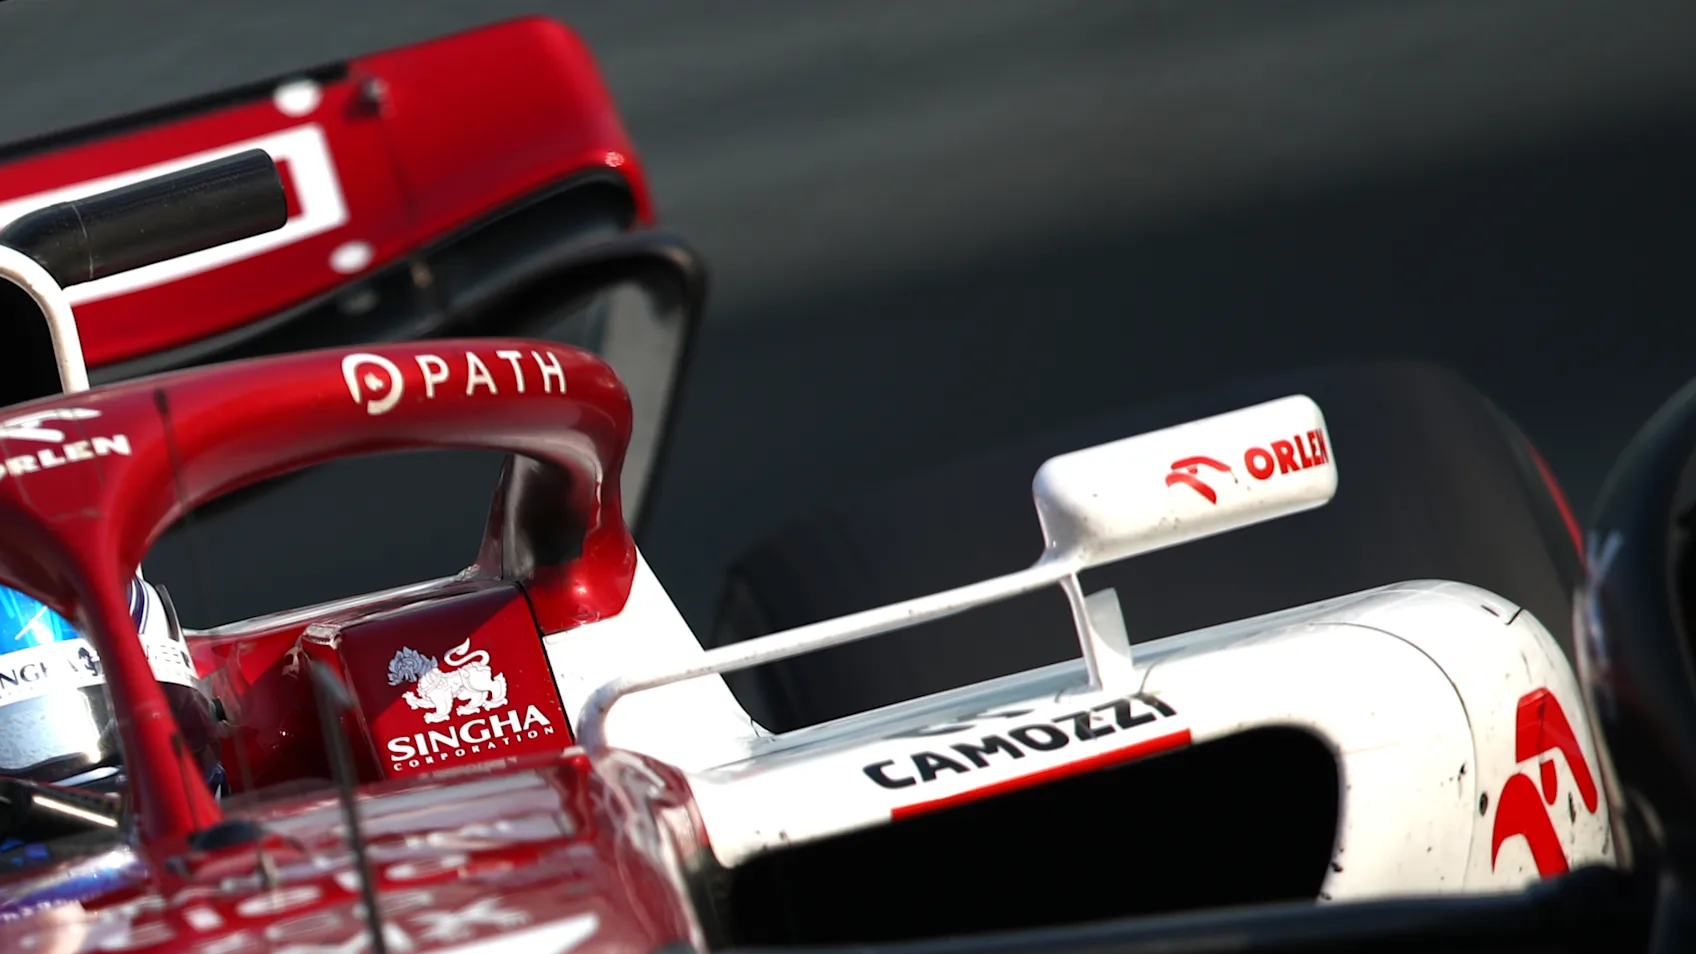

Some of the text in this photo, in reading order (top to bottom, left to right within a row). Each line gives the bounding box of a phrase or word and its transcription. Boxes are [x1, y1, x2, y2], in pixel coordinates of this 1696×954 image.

[415, 350, 567, 399] PATH
[1244, 428, 1329, 480] ORLEN
[387, 704, 551, 761] SINGHA
[393, 726, 555, 771] CORPORATION
[862, 693, 1177, 789] CAMOZZI
